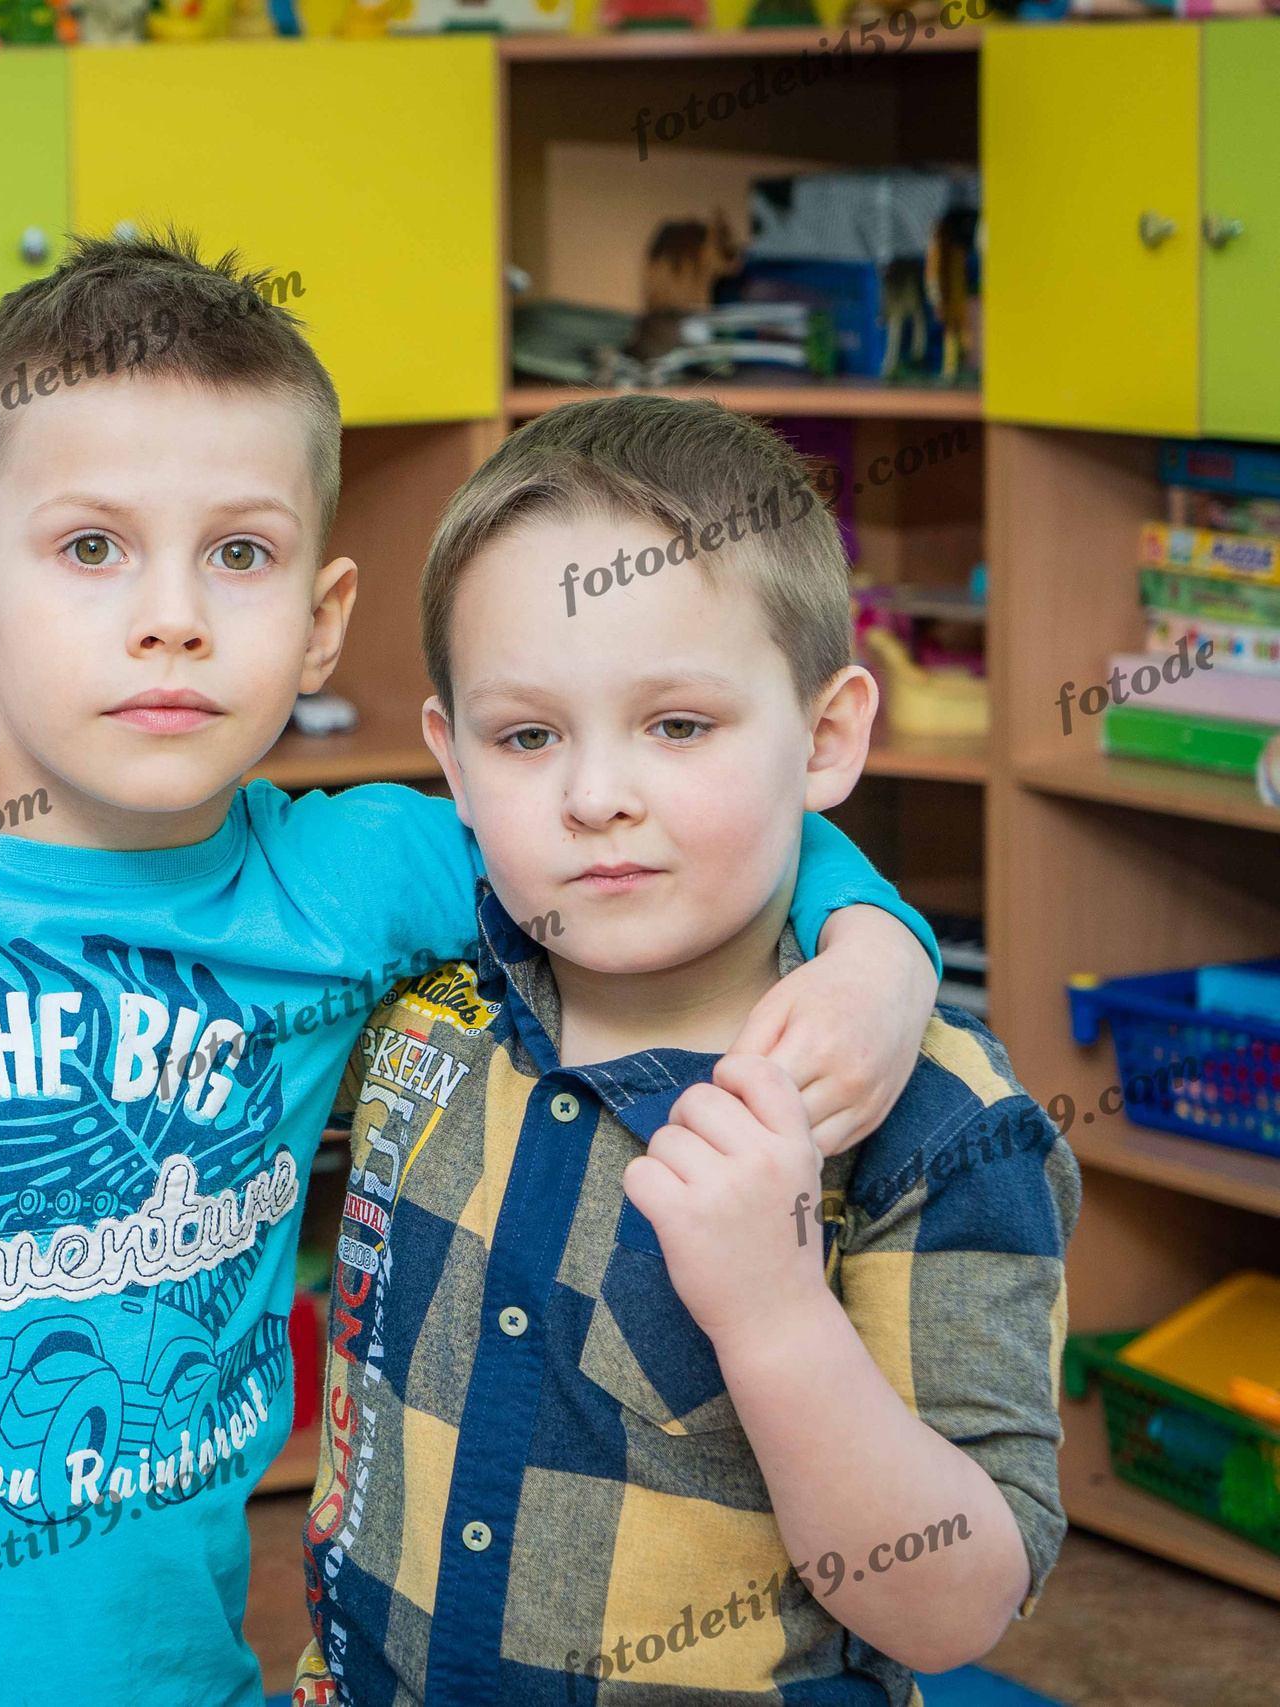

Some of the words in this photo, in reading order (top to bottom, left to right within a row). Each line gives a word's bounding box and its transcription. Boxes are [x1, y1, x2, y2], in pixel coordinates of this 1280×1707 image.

[111, 992, 246, 1123] BIG
[342, 1238, 371, 1270] 2008
[66, 1377, 269, 1504] Rainforest
